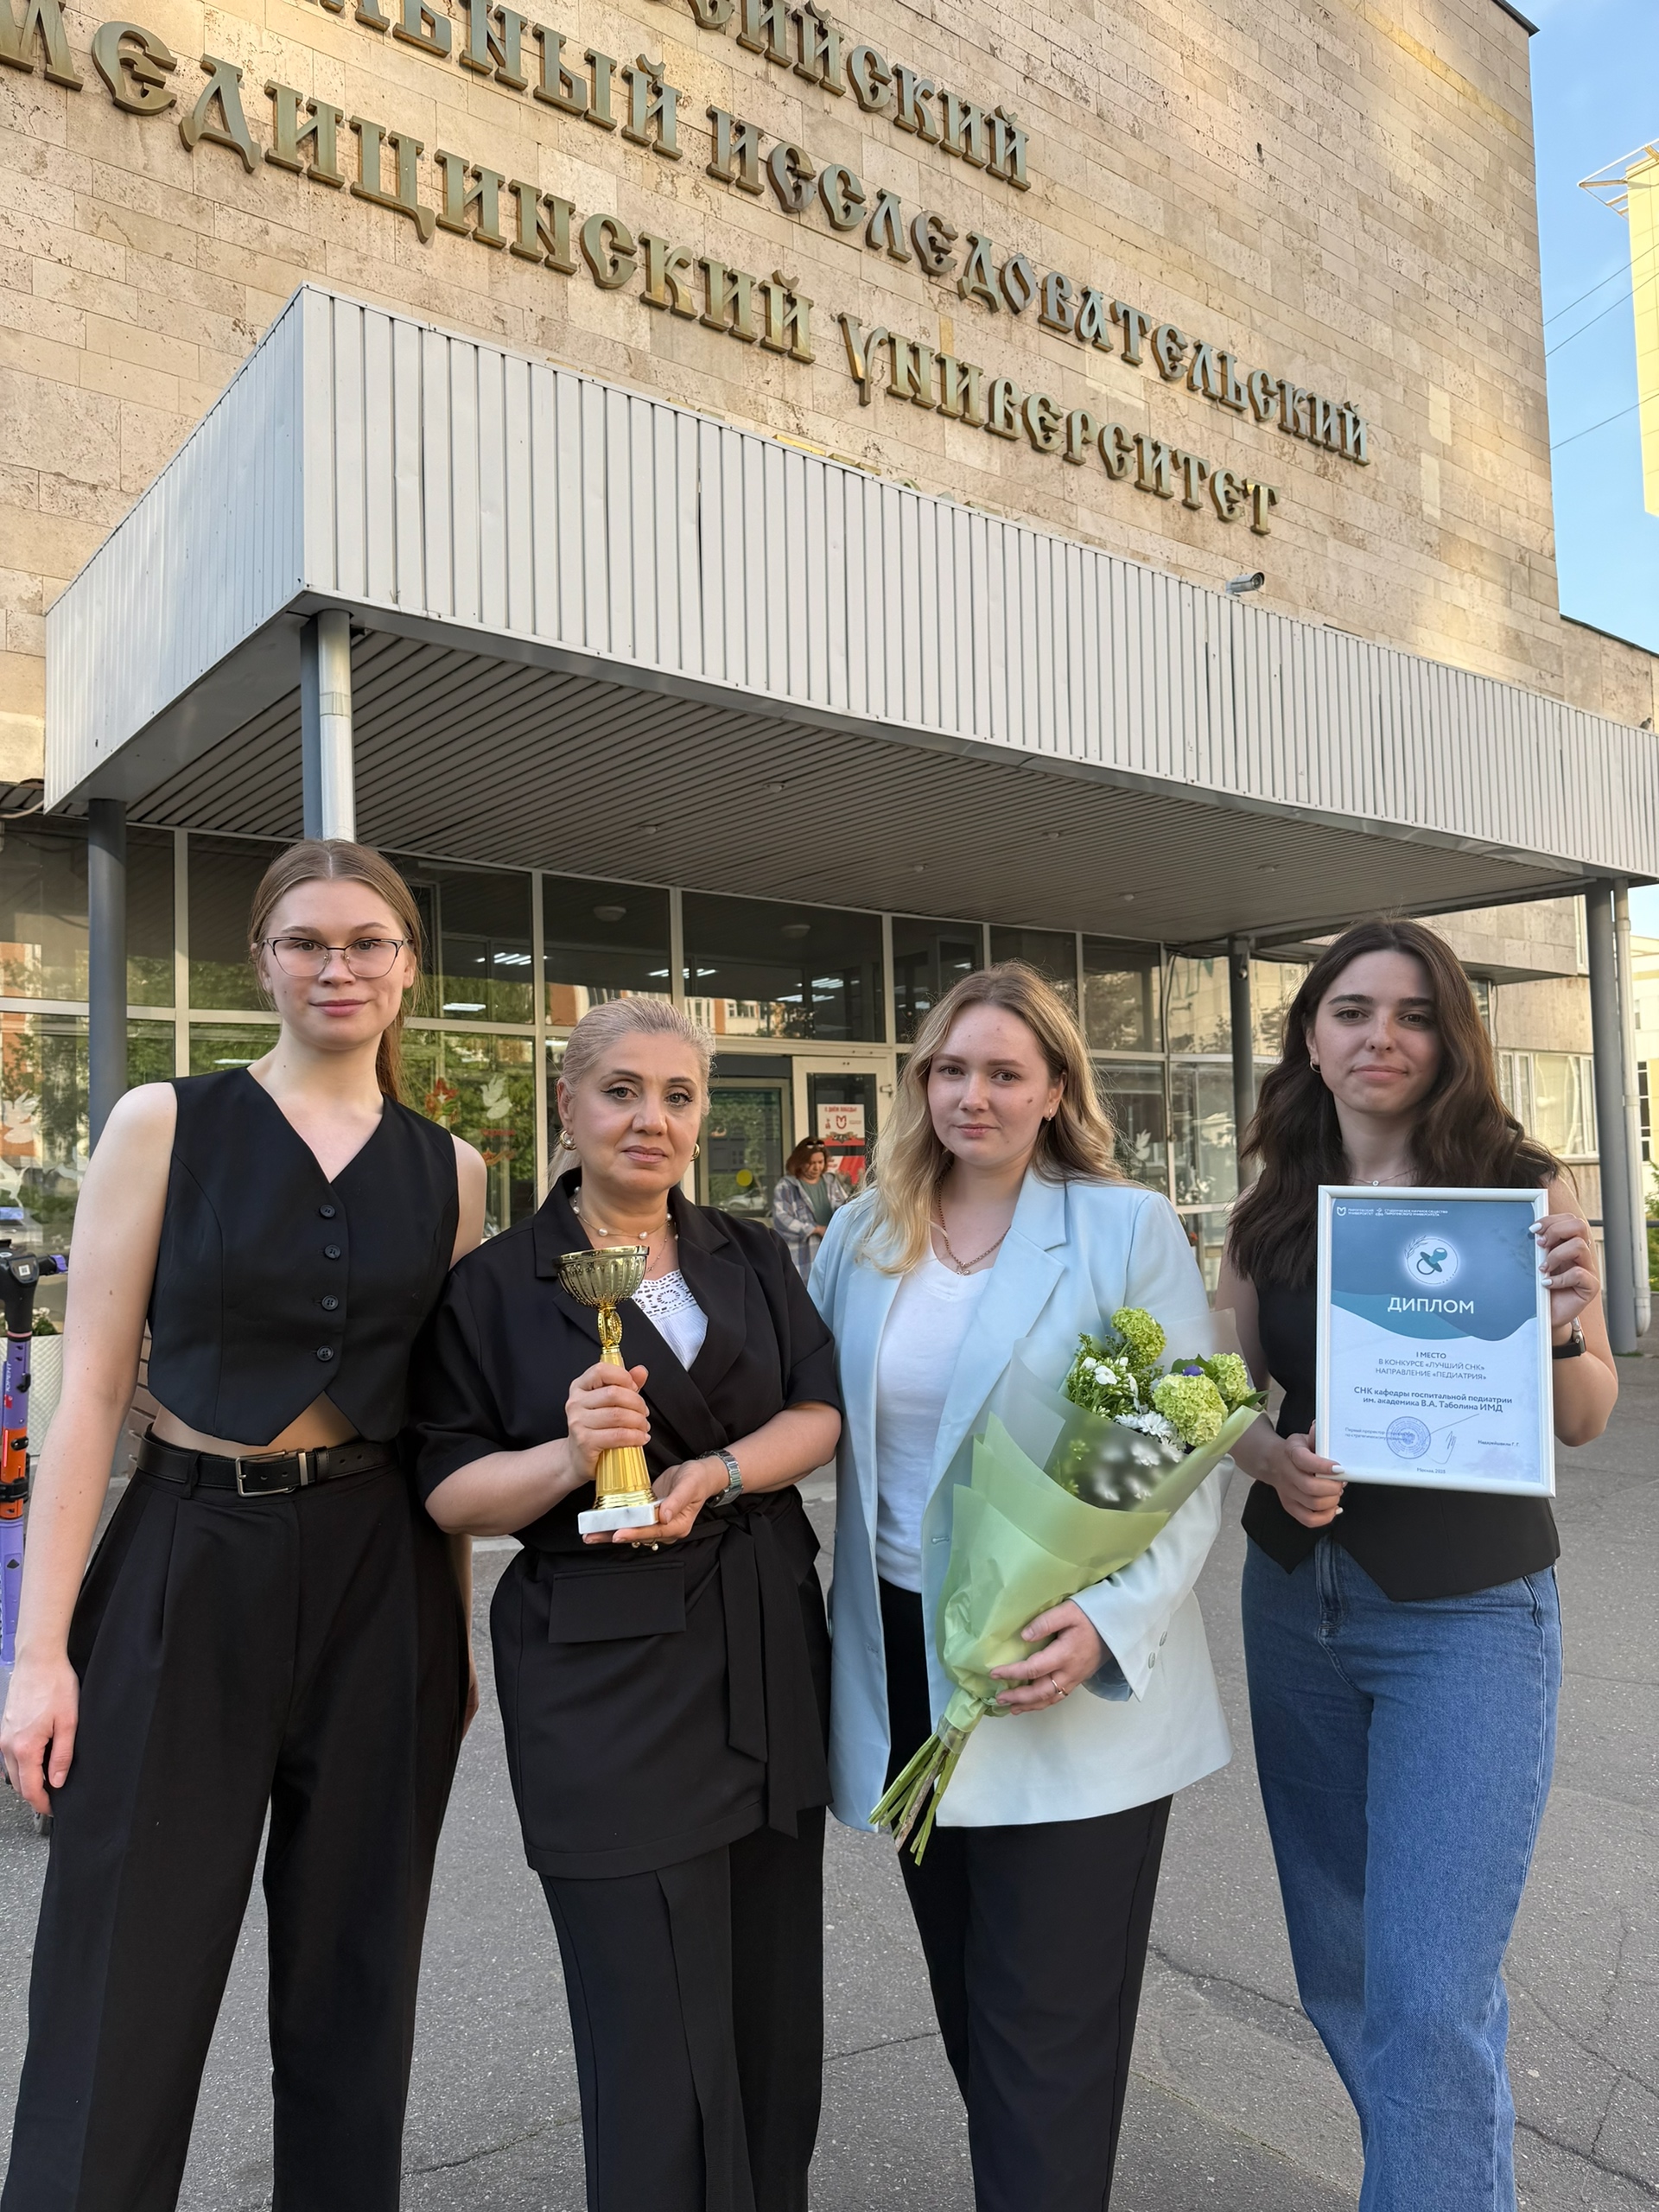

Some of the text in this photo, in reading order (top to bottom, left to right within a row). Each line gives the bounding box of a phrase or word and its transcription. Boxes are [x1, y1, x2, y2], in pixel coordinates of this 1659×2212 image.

[0, 0, 1281, 537] МЕДИЦИНСКИЙ УНИВЕРСИТЕТ
[706, 105, 1370, 467] ИССЛЕДОВАТЕЛЬСКИЙ
[1387, 1297, 1475, 1314] ДИПЛОМ
[1384, 1359, 1424, 1368] КОНКУРСЕ
[1425, 1361, 1464, 1370] «ЛУЧШИЙ
[1376, 1368, 1486, 1381] НАПРАВЛЕНИЕ «ПЕДИАТРИЯ»
[1354, 1386, 1513, 1404] СНК кафедры госпитальной педиатрии
[1377, 1398, 1420, 1407] академика
[1439, 1401, 1478, 1411] Таболина
[1479, 1403, 1503, 1413] ИМД
